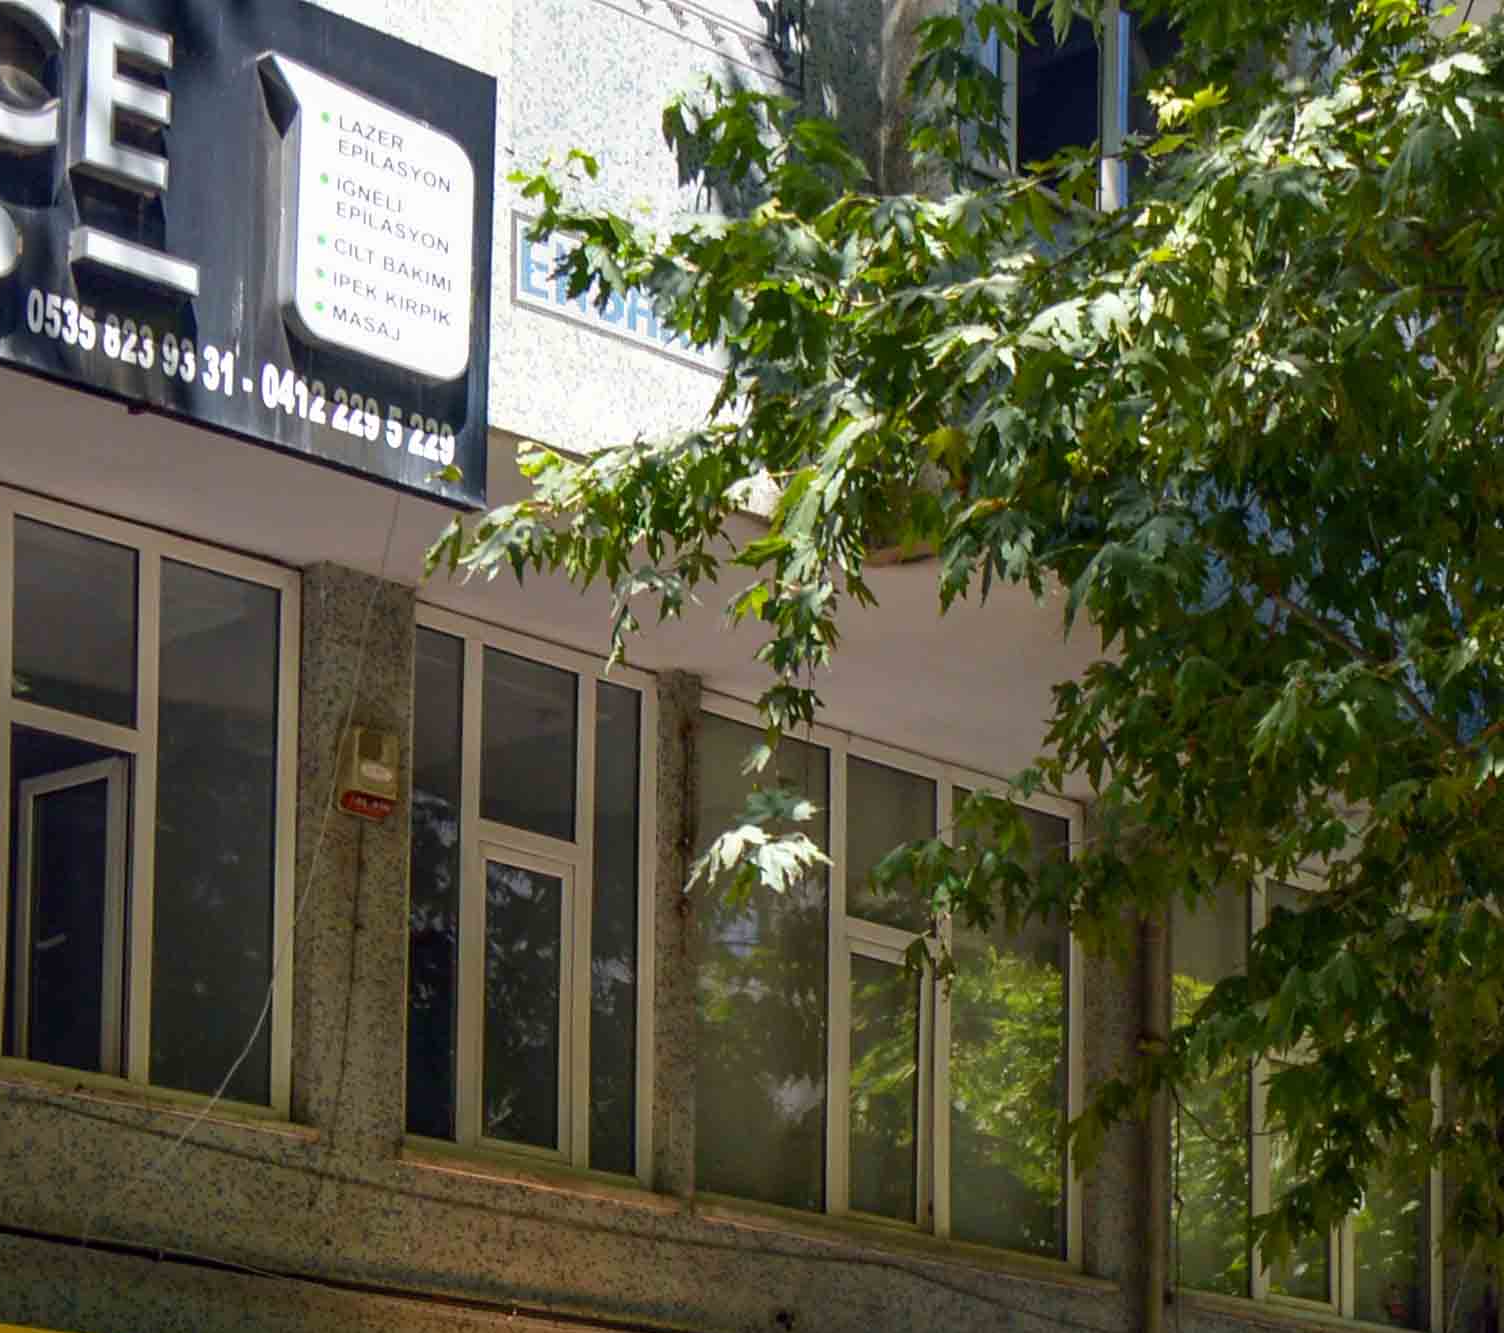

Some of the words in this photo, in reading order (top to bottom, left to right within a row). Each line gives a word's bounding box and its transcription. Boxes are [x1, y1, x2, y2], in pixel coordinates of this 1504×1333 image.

[339, 114, 404, 153] LAZER
[332, 304, 402, 342] MASAJ
[26, 287, 97, 352] 0535
[103, 312, 155, 370] 823
[162, 328, 196, 383] 93
[202, 344, 235, 396] 31
[262, 363, 327, 425] 0412
[332, 382, 380, 442] 229
[386, 405, 403, 449] 5
[408, 412, 455, 465] 229
